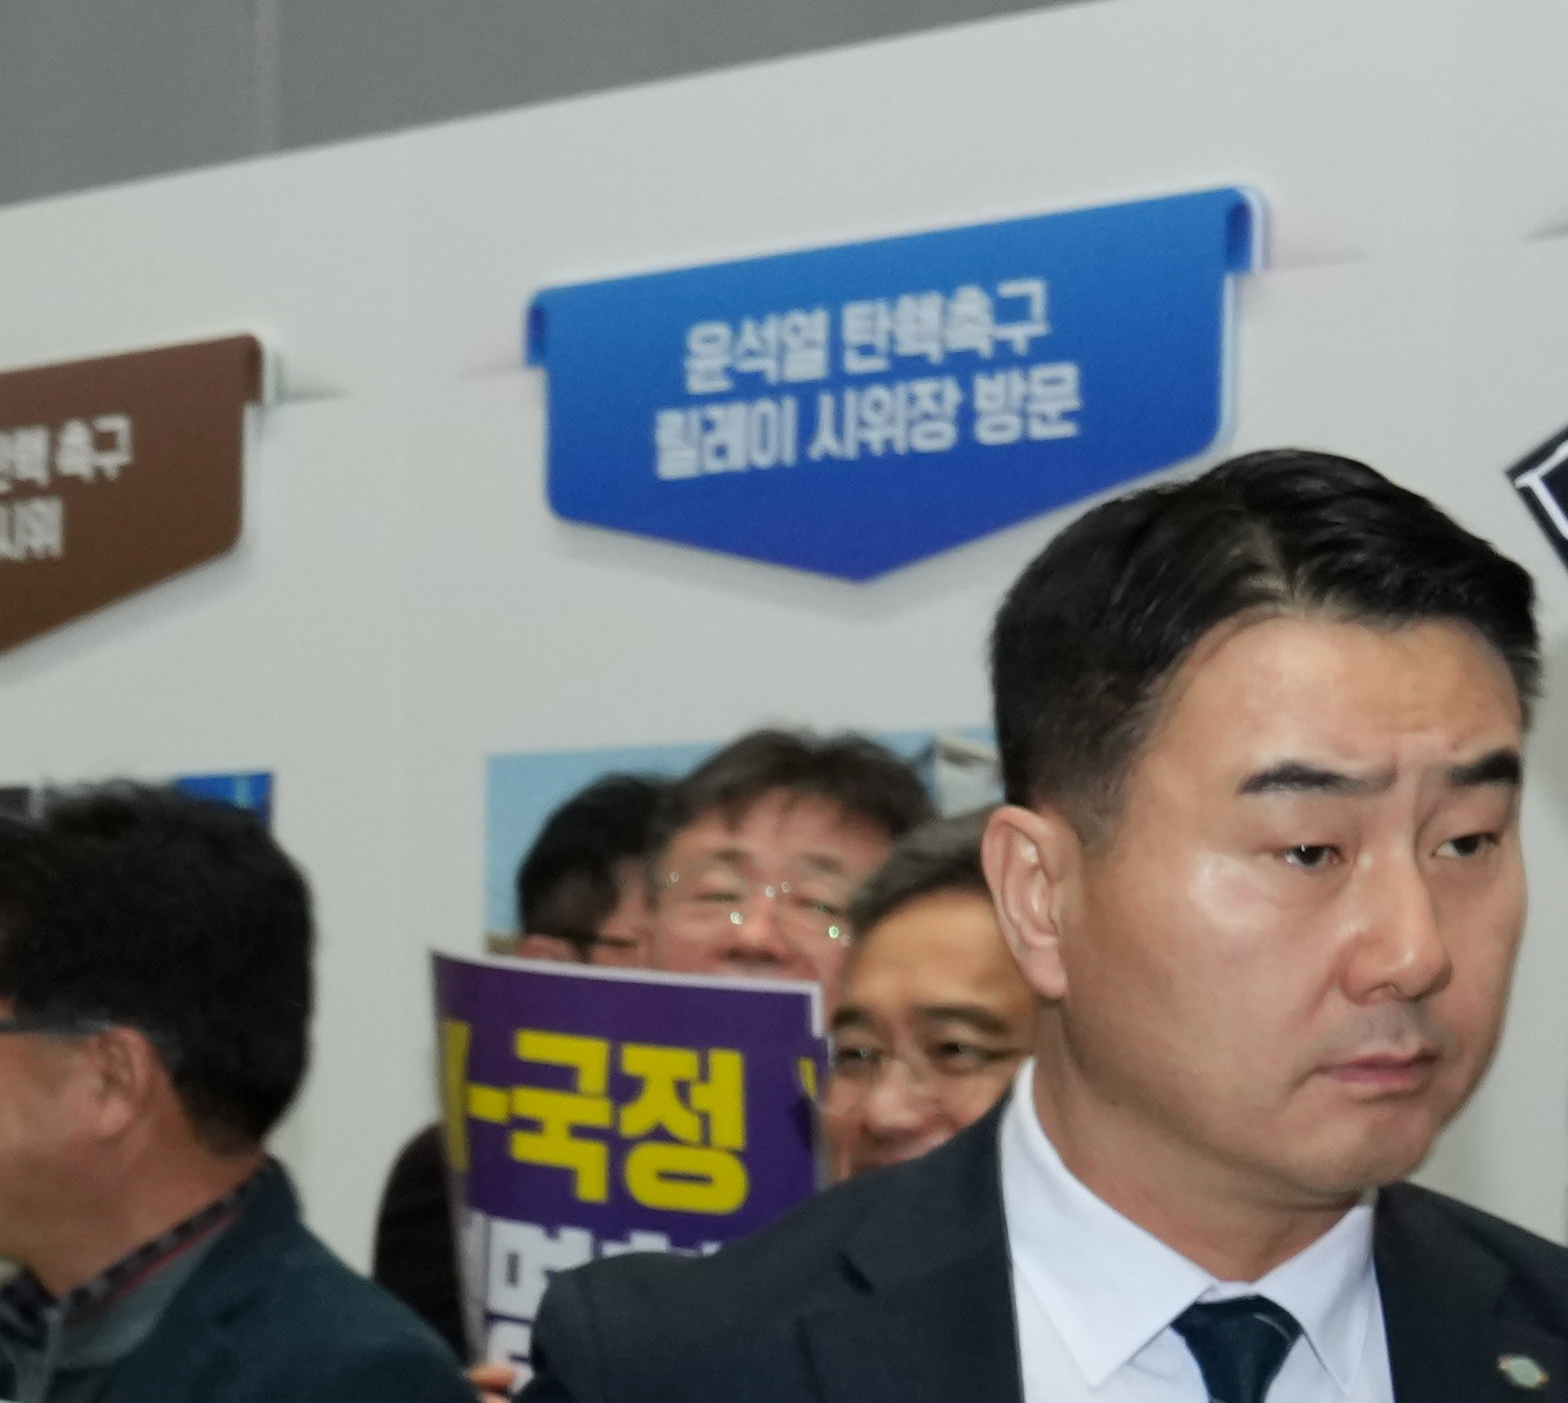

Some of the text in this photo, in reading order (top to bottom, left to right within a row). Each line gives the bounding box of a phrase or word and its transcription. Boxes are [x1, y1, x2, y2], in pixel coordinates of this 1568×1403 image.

[685, 308, 830, 395] 윤석열
[656, 361, 1082, 481] 릴레이 시위장 방문
